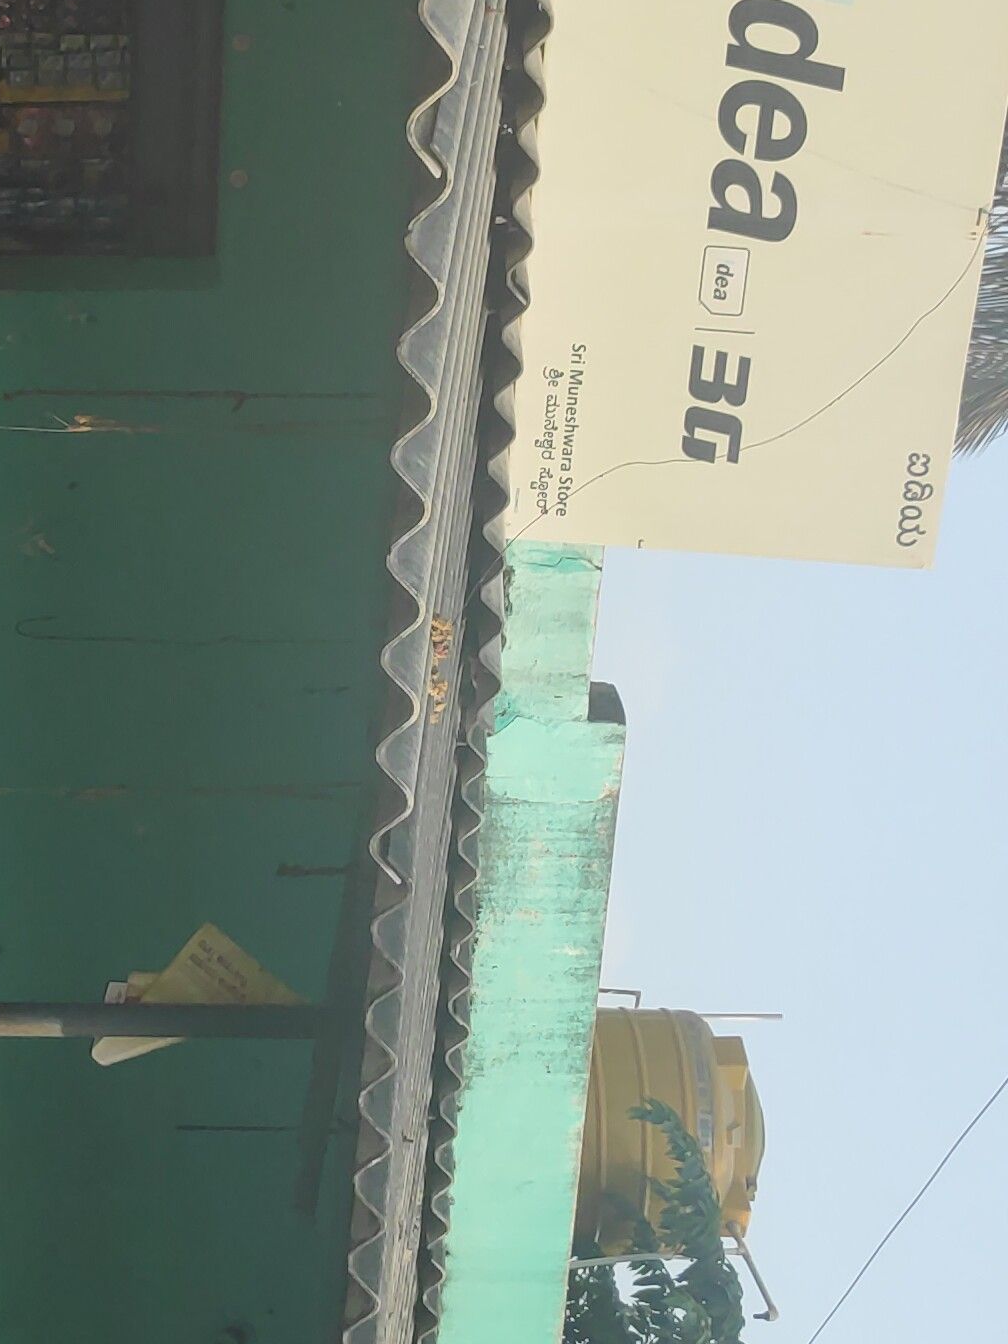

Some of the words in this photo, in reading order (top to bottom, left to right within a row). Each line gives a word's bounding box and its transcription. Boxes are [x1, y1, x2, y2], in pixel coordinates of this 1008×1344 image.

[570, 344, 587, 365] Sri
[559, 369, 584, 472] Muneshwara
[681, 344, 752, 465] 3G
[555, 476, 574, 517] Store
